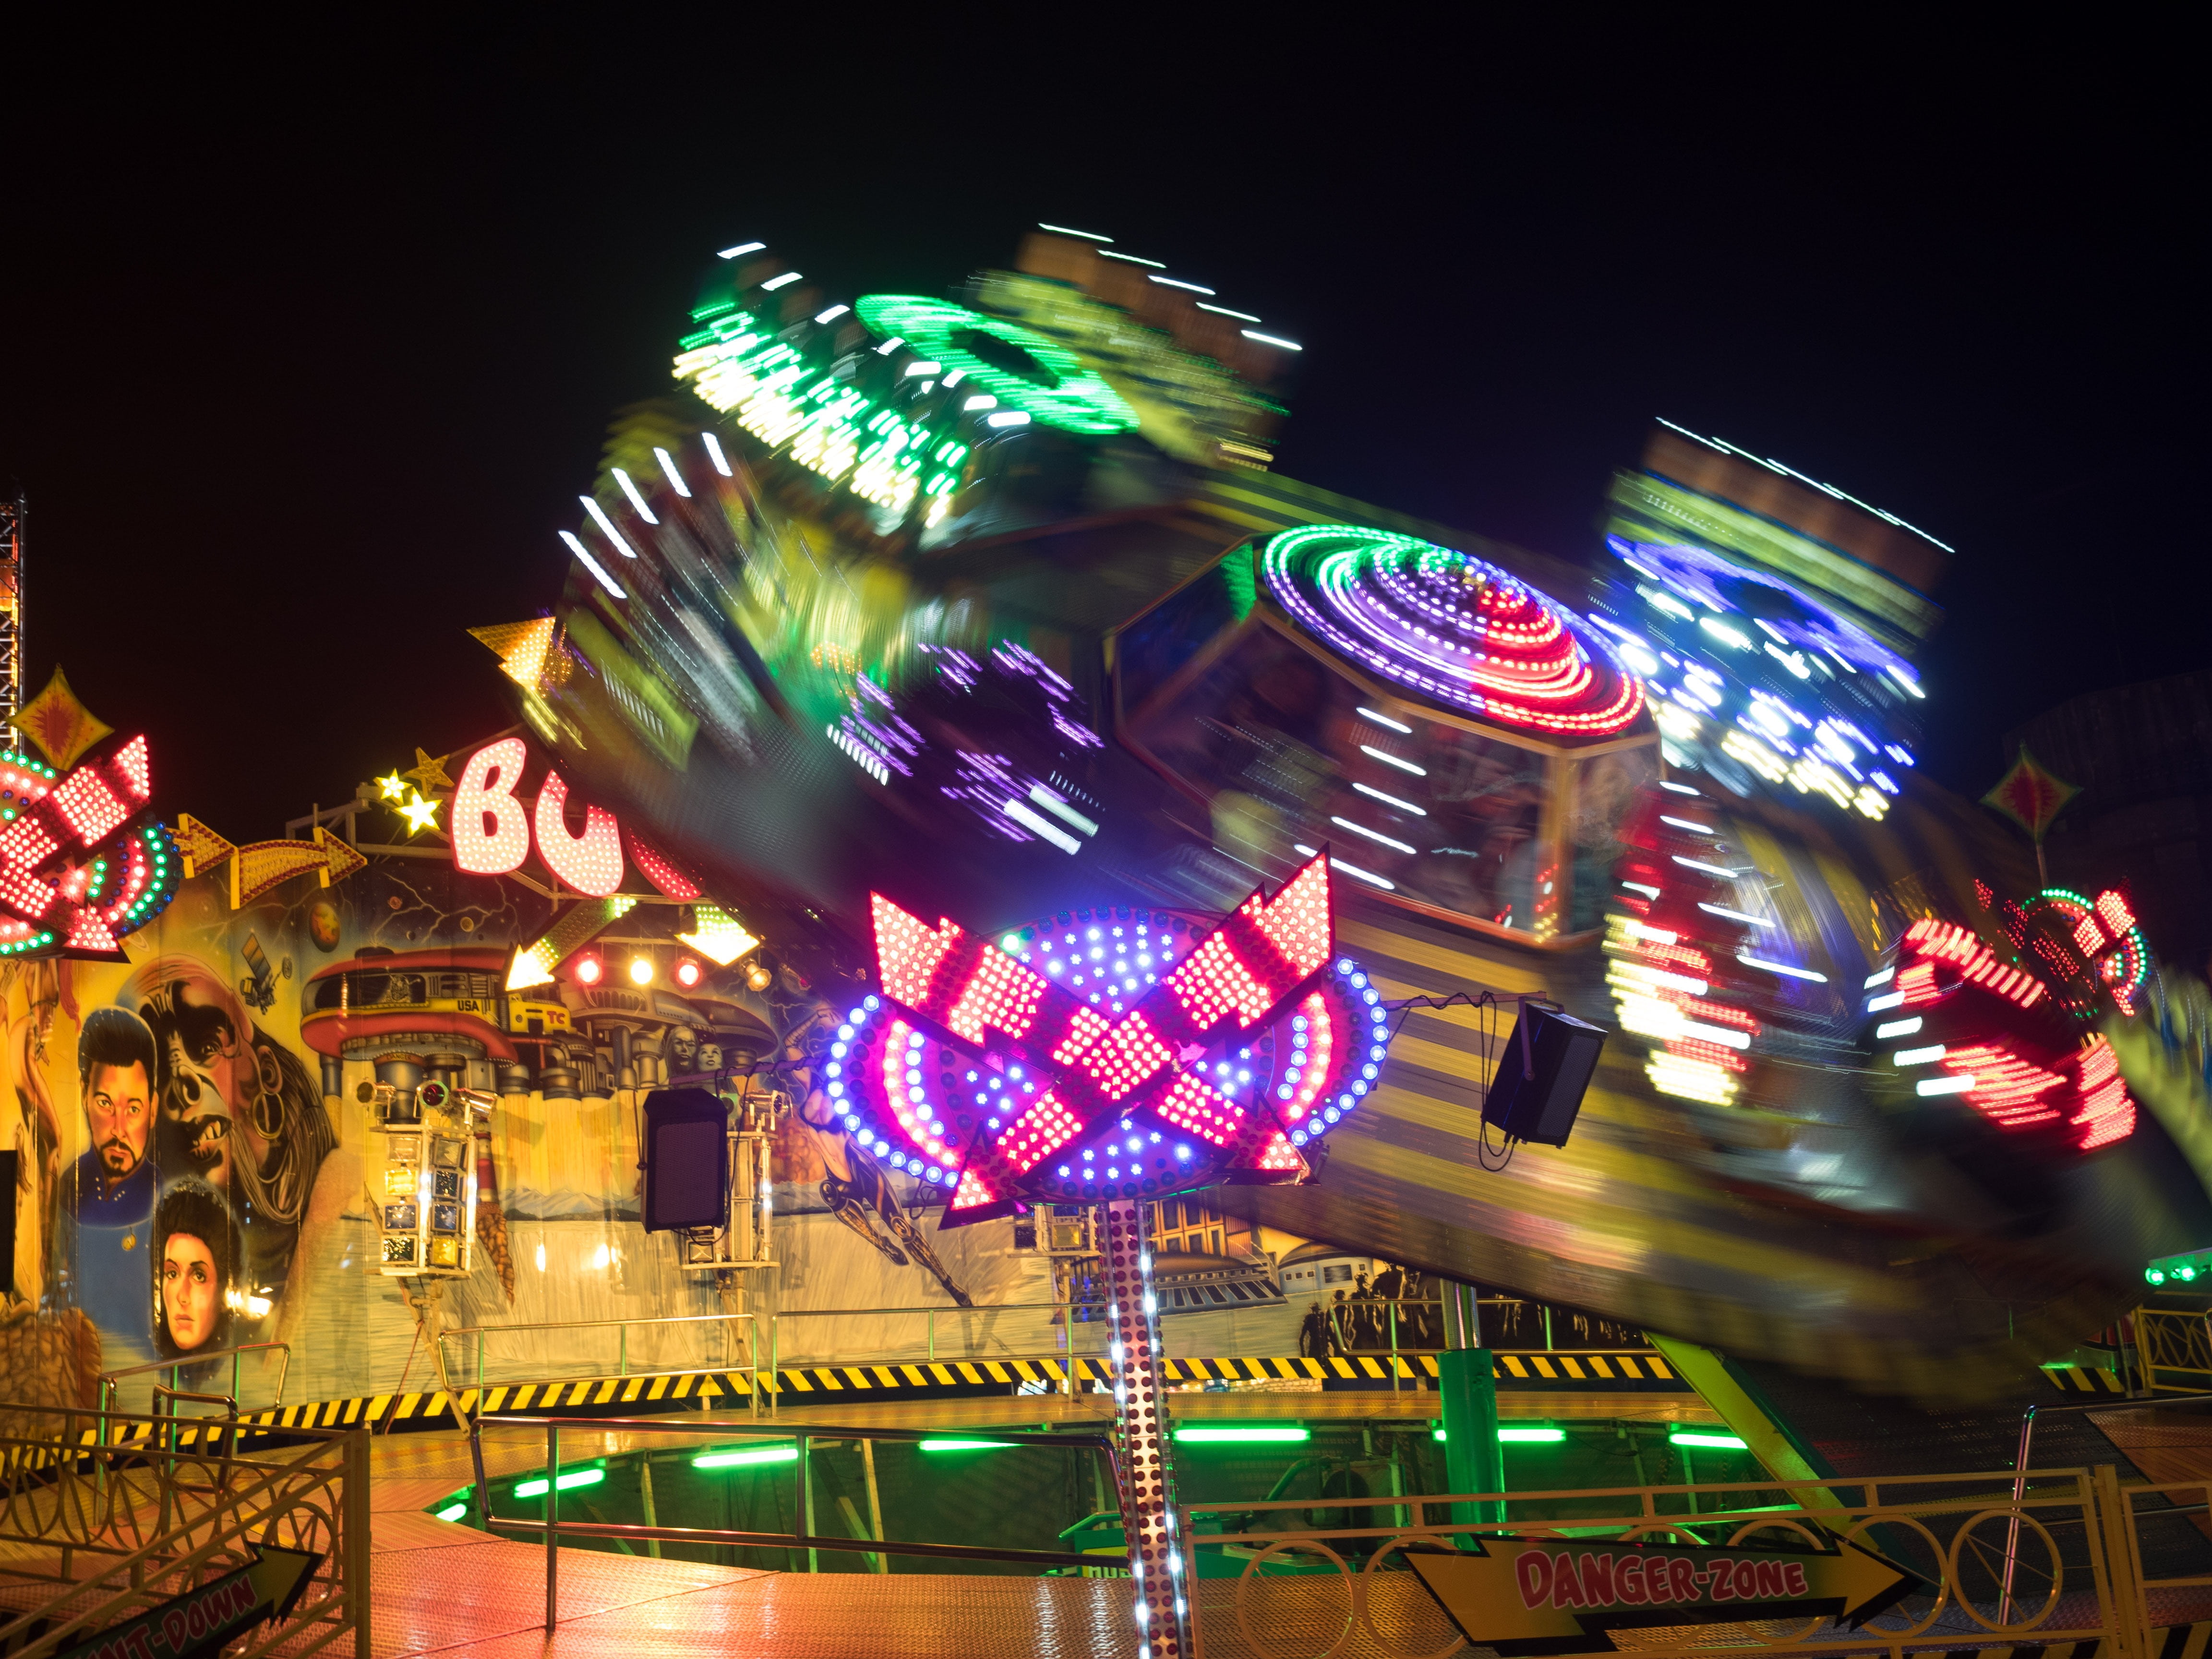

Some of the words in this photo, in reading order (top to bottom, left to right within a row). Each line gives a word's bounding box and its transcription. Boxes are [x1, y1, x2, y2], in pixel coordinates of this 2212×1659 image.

[452, 737, 702, 902] BU
[457, 1000, 479, 1012] USA
[547, 1010, 565, 1024] TC
[385, 1053, 411, 1061] DANGER
[1515, 1549, 1809, 1611] DANGER-ZONE
[75, 1573, 259, 1659] NT-DOWN
